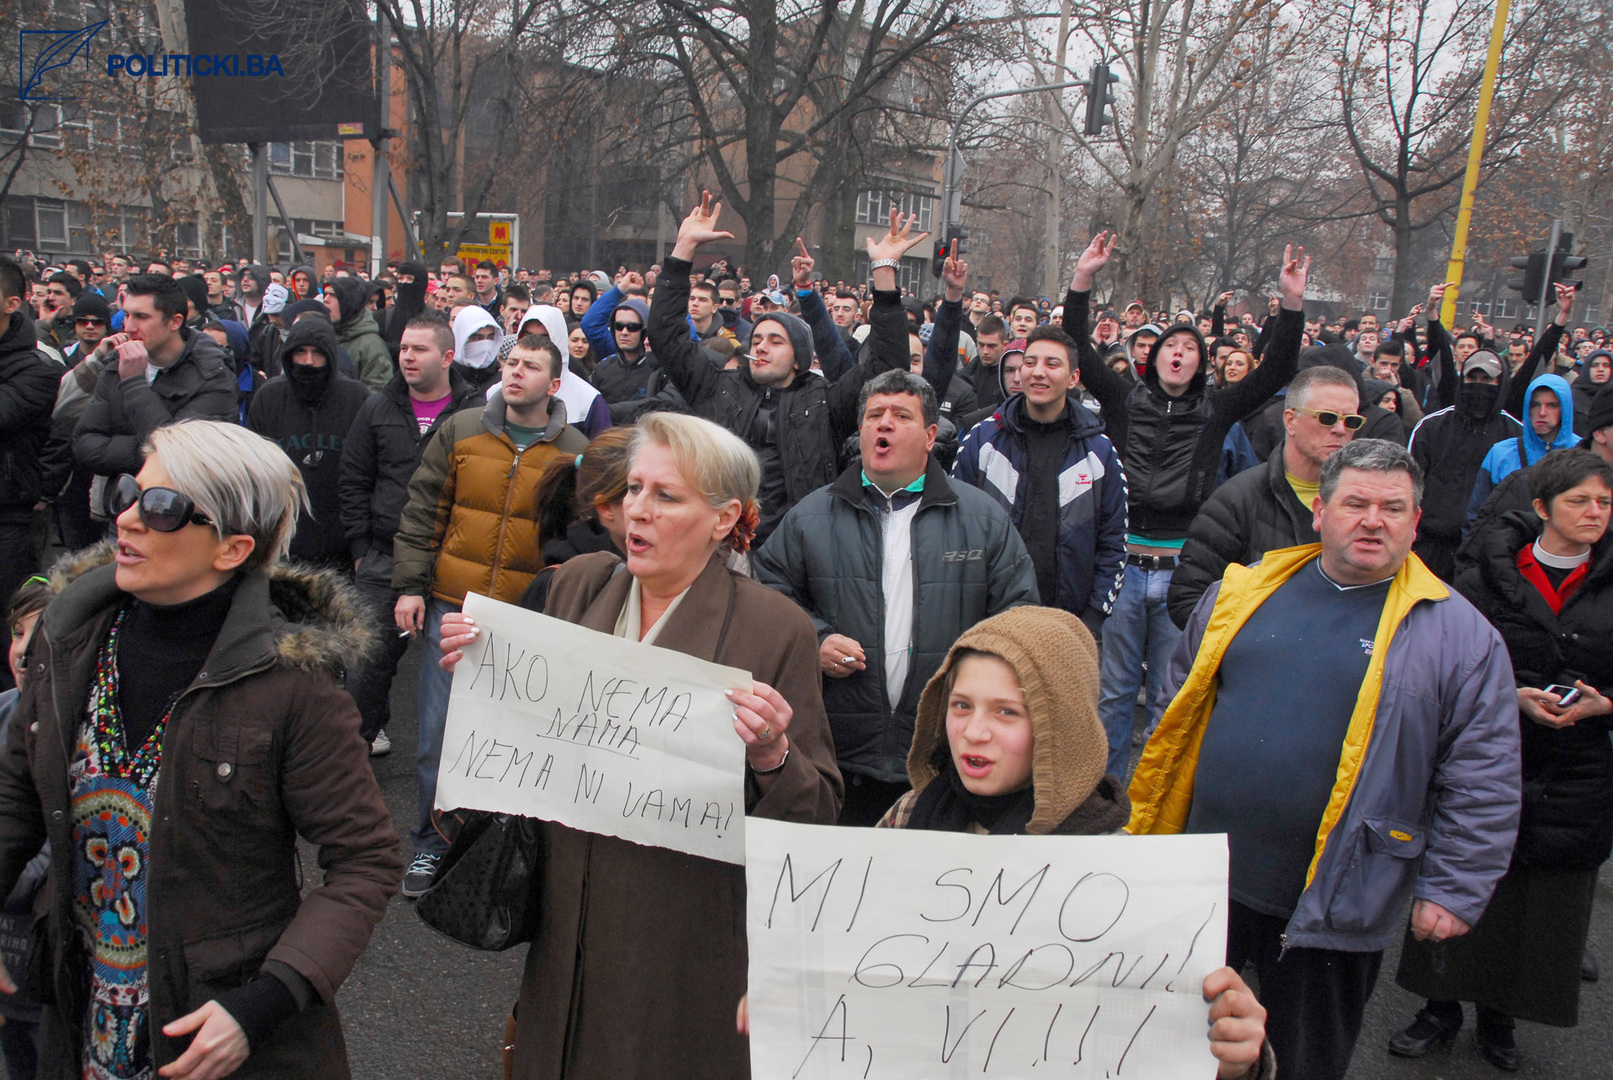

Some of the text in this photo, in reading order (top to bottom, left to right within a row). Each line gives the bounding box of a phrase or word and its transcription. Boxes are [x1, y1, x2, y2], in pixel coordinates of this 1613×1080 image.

[470, 632, 693, 732] AKO NEMA
[545, 707, 641, 755] NAMA
[448, 729, 734, 839] NEMA NI VAMA!
[765, 852, 1130, 942] MI SMO
[848, 902, 1217, 993] GLADNI!
